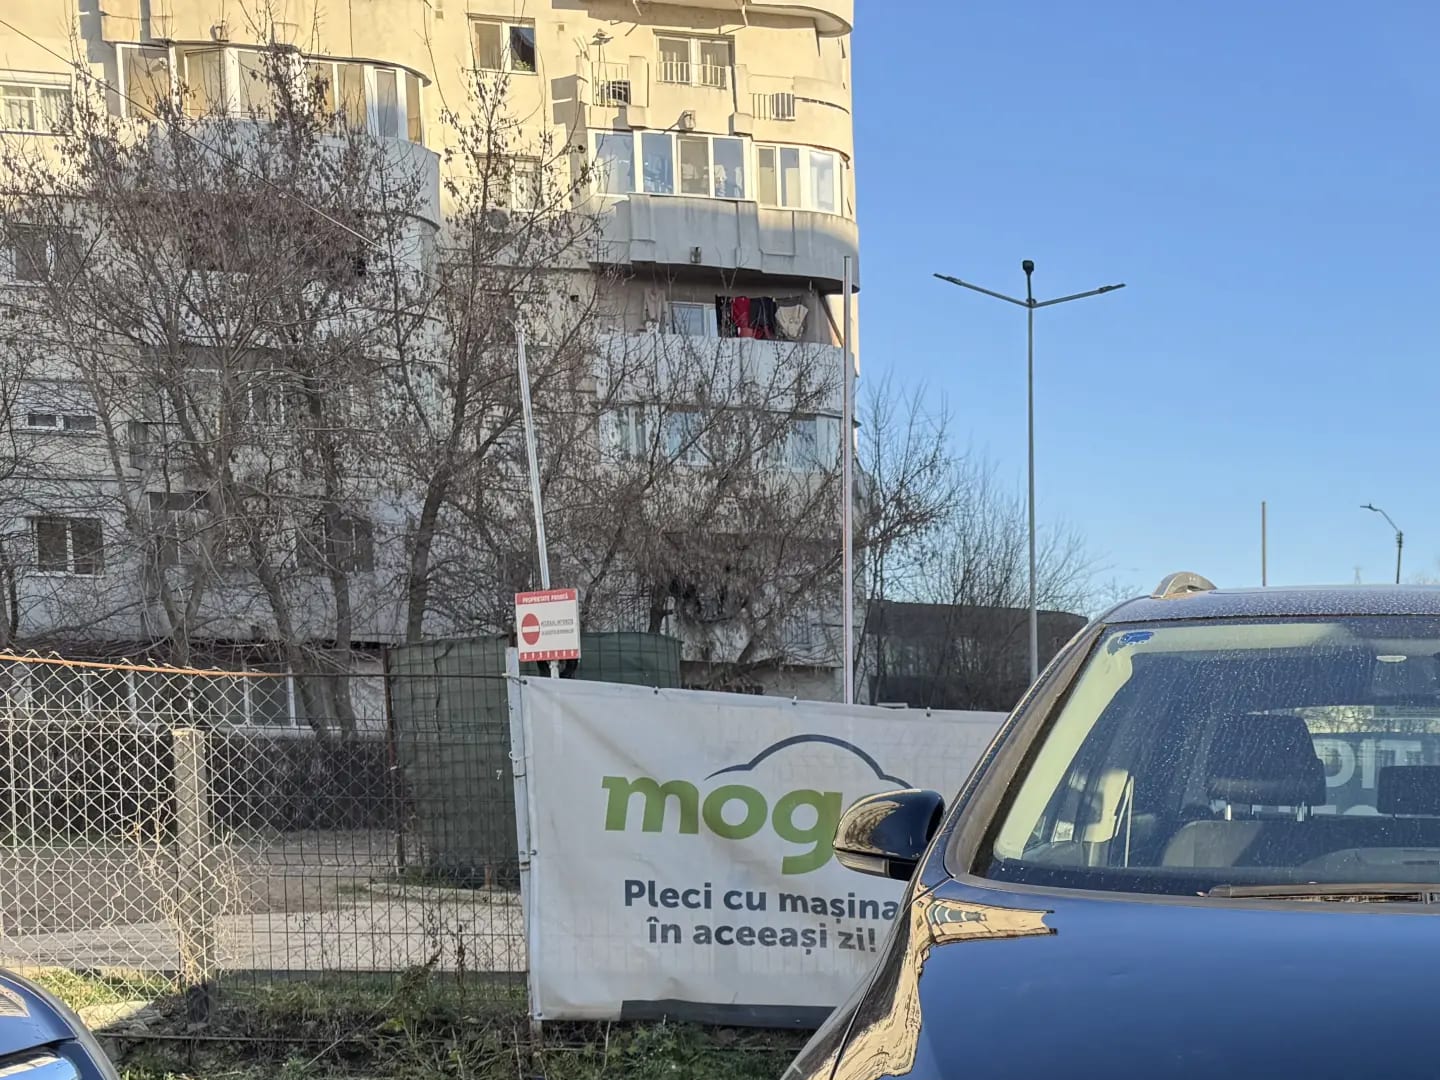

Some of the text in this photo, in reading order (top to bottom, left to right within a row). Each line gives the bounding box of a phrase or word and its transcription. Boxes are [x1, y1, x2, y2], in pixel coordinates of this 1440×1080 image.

[602, 775, 858, 875] mog
[624, 879, 712, 909] Pleci
[723, 889, 767, 911] cu
[646, 916, 876, 955] în aceeași zi!
